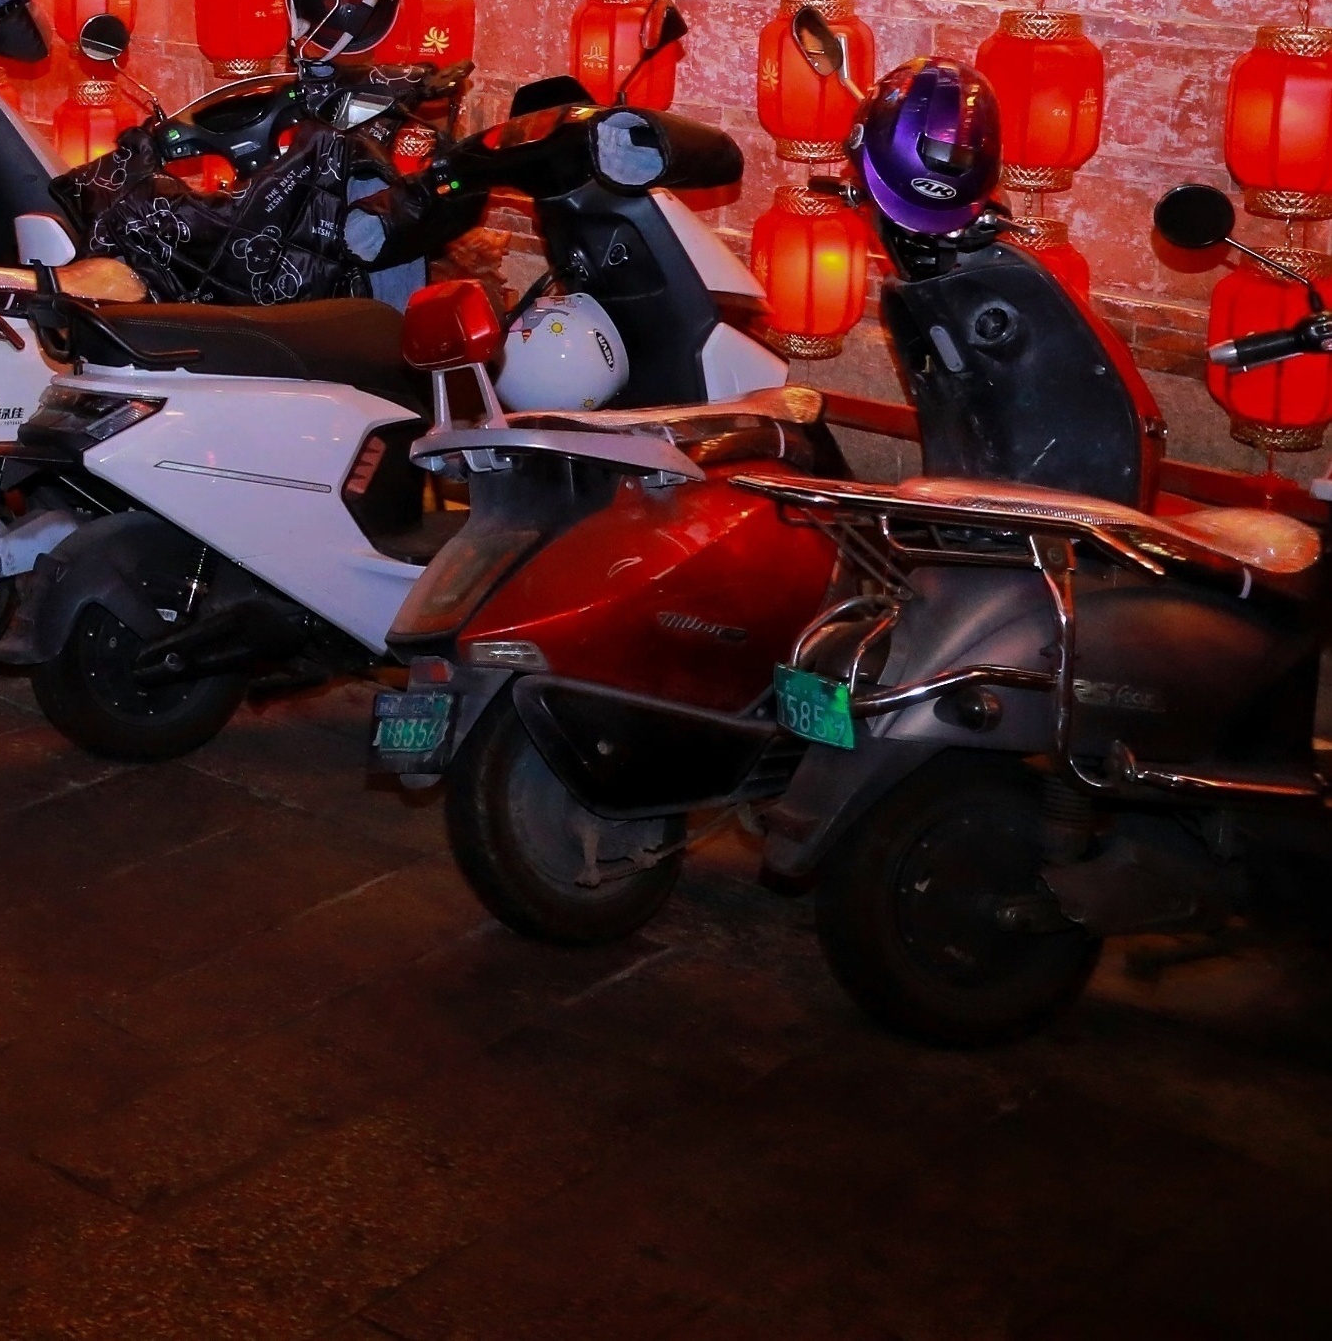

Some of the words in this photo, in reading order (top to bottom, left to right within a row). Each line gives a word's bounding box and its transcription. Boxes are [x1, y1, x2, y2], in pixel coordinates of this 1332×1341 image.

[369, 128, 383, 141] FOR
[265, 187, 280, 202] THE
[279, 169, 297, 187] BEST
[265, 196, 284, 214] WISH
[284, 180, 297, 195] FOR
[297, 165, 311, 180] YOU
[320, 219, 334, 229] THE
[311, 228, 331, 237] WISH
